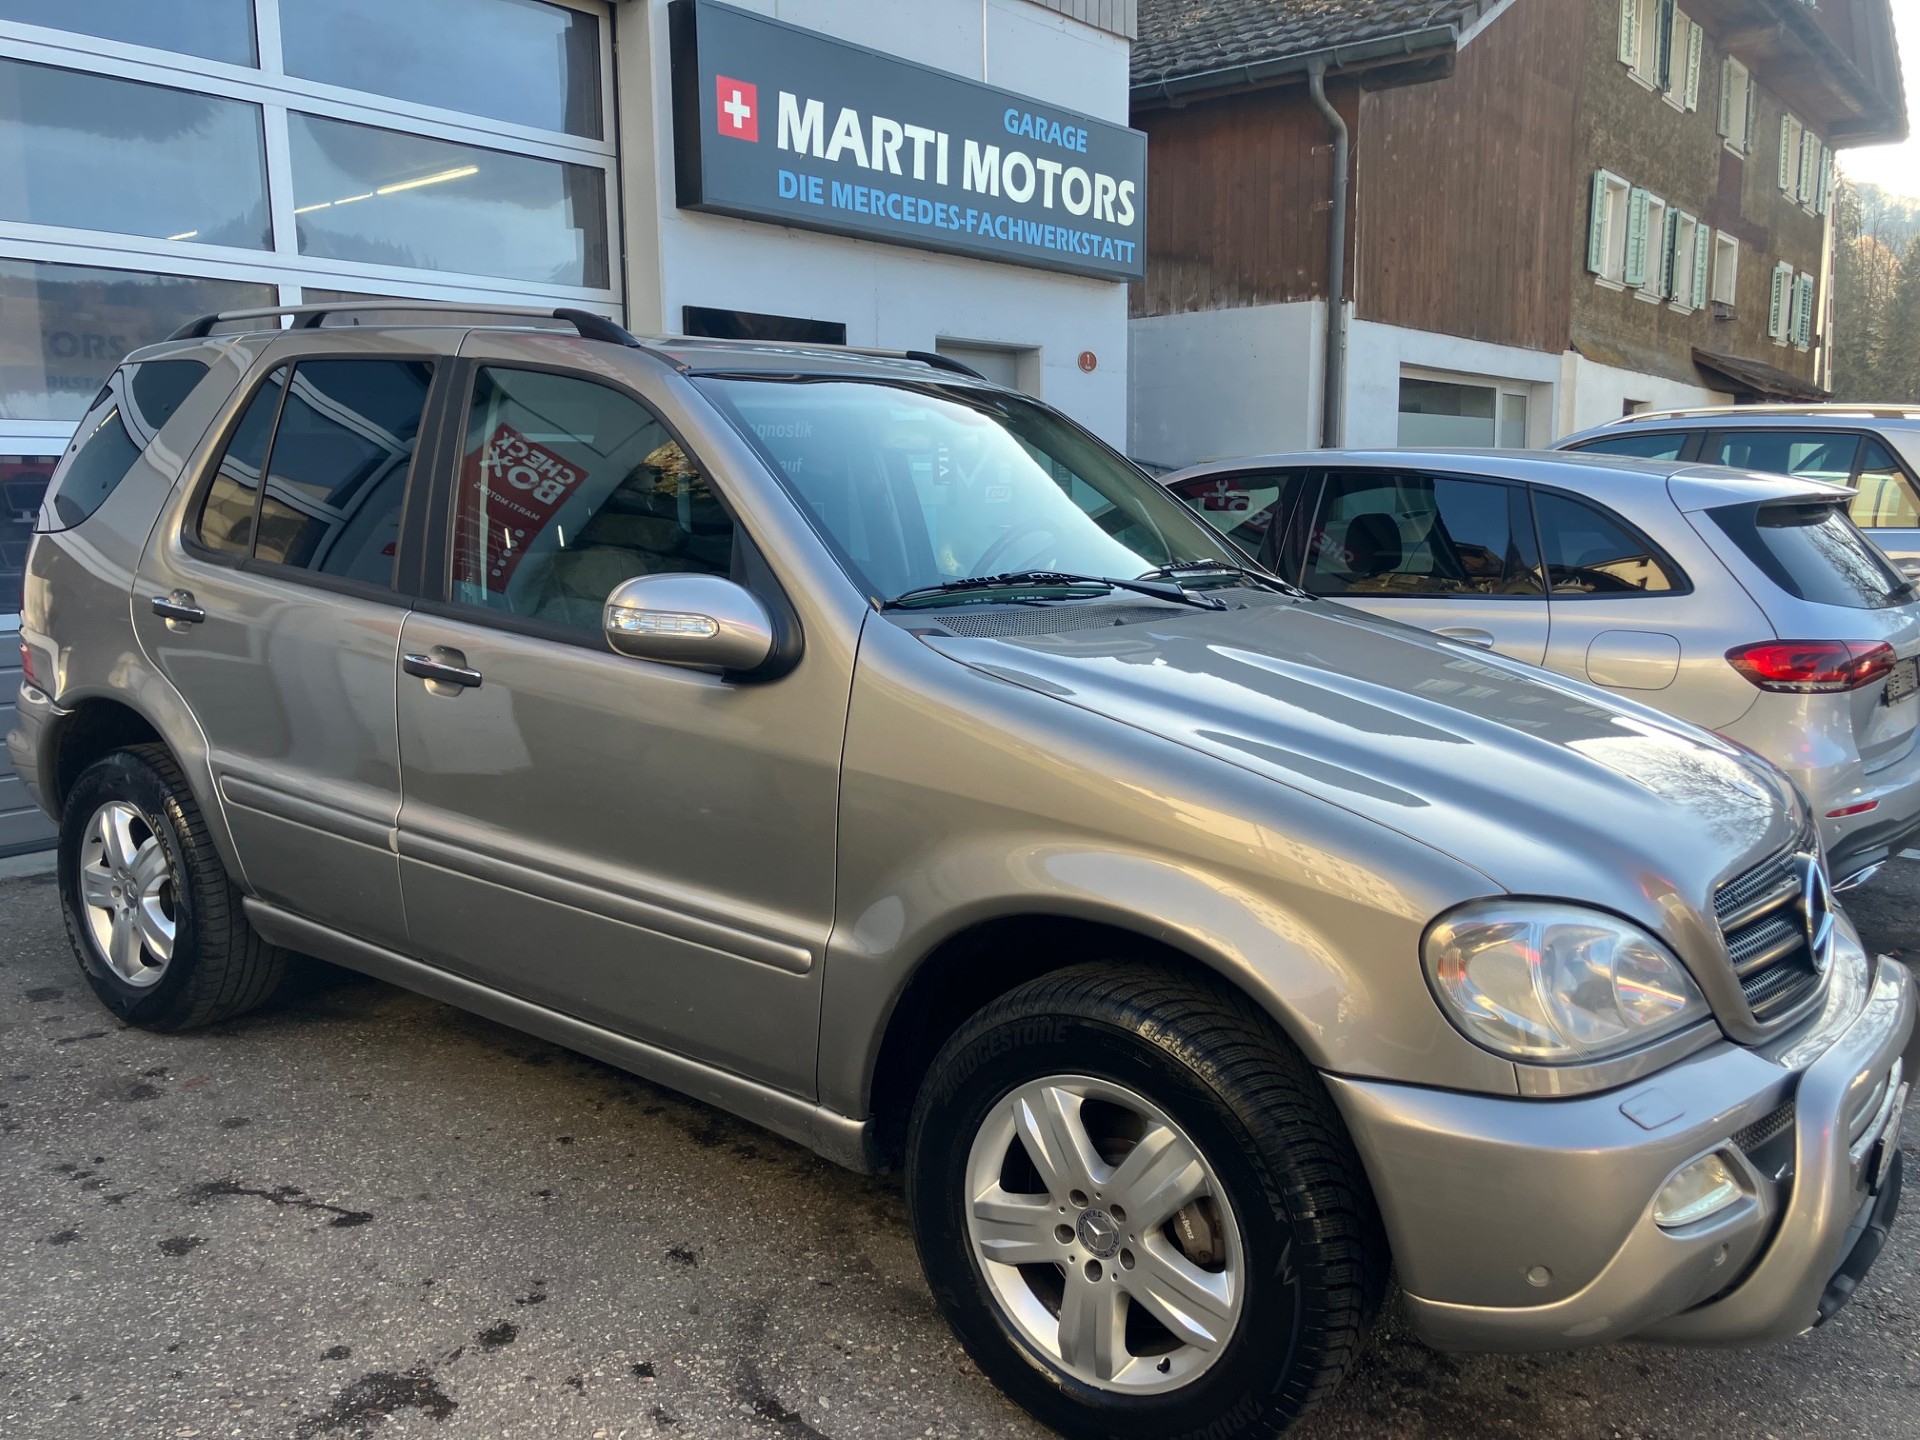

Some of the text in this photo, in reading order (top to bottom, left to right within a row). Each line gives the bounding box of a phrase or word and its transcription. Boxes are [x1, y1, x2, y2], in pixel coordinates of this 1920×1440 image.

[777, 90, 1135, 227] MARTI MOTORS
[1004, 108, 1087, 153] GARAGE
[778, 169, 1136, 263] DIE MERCEDES-FACHWERKSTATT
[44, 331, 128, 359] ORS
[939, 1019, 1070, 1105] BRIDGESTONE
